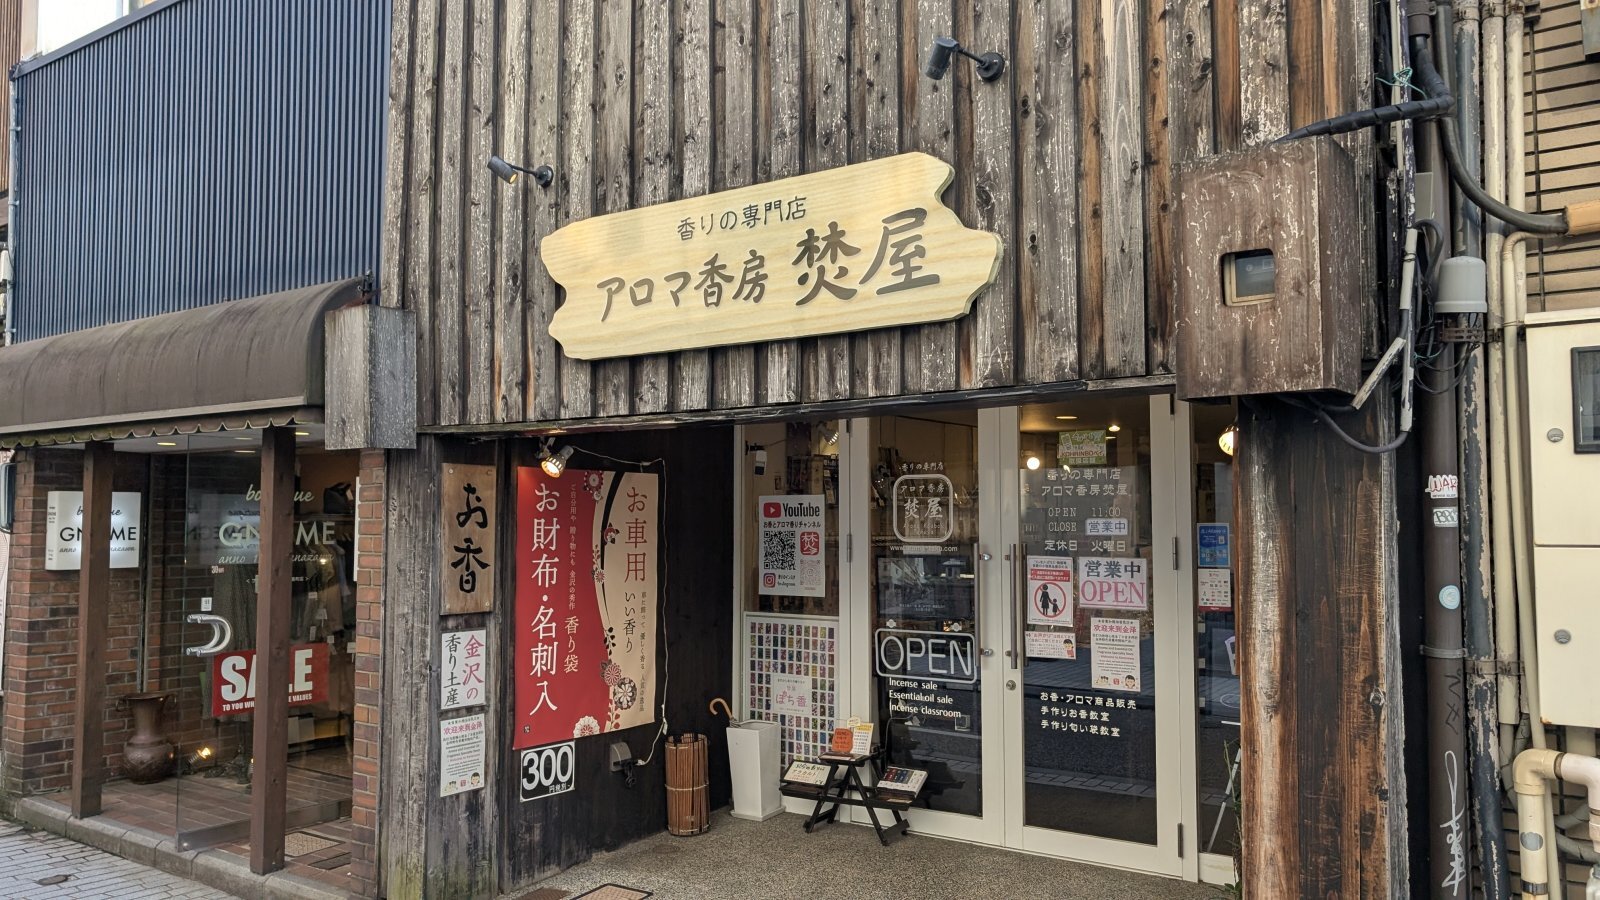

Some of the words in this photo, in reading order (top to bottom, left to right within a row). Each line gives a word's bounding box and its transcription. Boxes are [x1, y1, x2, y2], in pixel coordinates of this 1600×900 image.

[677, 196, 807, 241] 香りの専門店
[597, 249, 768, 322] アロマ香房
[792, 207, 940, 306] 焚屋
[901, 462, 944, 472] 香りの専門店
[1047, 468, 1121, 480] 香りの専門店
[901, 483, 945, 494] アロマ香房
[1041, 484, 1128, 496] アロマ香房焚屋
[782, 502, 820, 517] YouTube
[903, 497, 943, 519] 焚屋
[1048, 507, 1077, 517] OPEN
[1092, 507, 1121, 517] 11:00
[624, 486, 648, 583] お車用
[1048, 522, 1077, 532] CLOSE
[1088, 521, 1126, 533] 営業中
[451, 483, 490, 594] お香
[1044, 540, 1078, 551] 定休日
[1091, 540, 1126, 552] 火曜日
[1084, 559, 1142, 579] 営業中
[529, 483, 560, 716] お財布・名刺入
[1080, 579, 1146, 606] OPEN
[623, 591, 636, 654] いい香り
[564, 616, 580, 674] 香り袋
[881, 636, 971, 676] OPEN
[443, 634, 462, 707] 香り土産
[463, 634, 485, 700] 金沢の
[889, 677, 918, 689] Incense
[922, 681, 938, 691] sale
[293, 693, 313, 703] VALUES
[889, 690, 923, 701] Essential
[924, 693, 935, 702] oil
[936, 695, 953, 705] sale
[1040, 692, 1137, 710] お香・アロマ商品販売
[222, 703, 230, 712] TO
[232, 702, 243, 710] YOU
[889, 702, 918, 713] Incense
[921, 706, 961, 719] classroom
[1041, 706, 1110, 722] 手作りお香教室
[1041, 720, 1121, 737] 手作り匂い袋教室
[522, 746, 573, 791] 300
